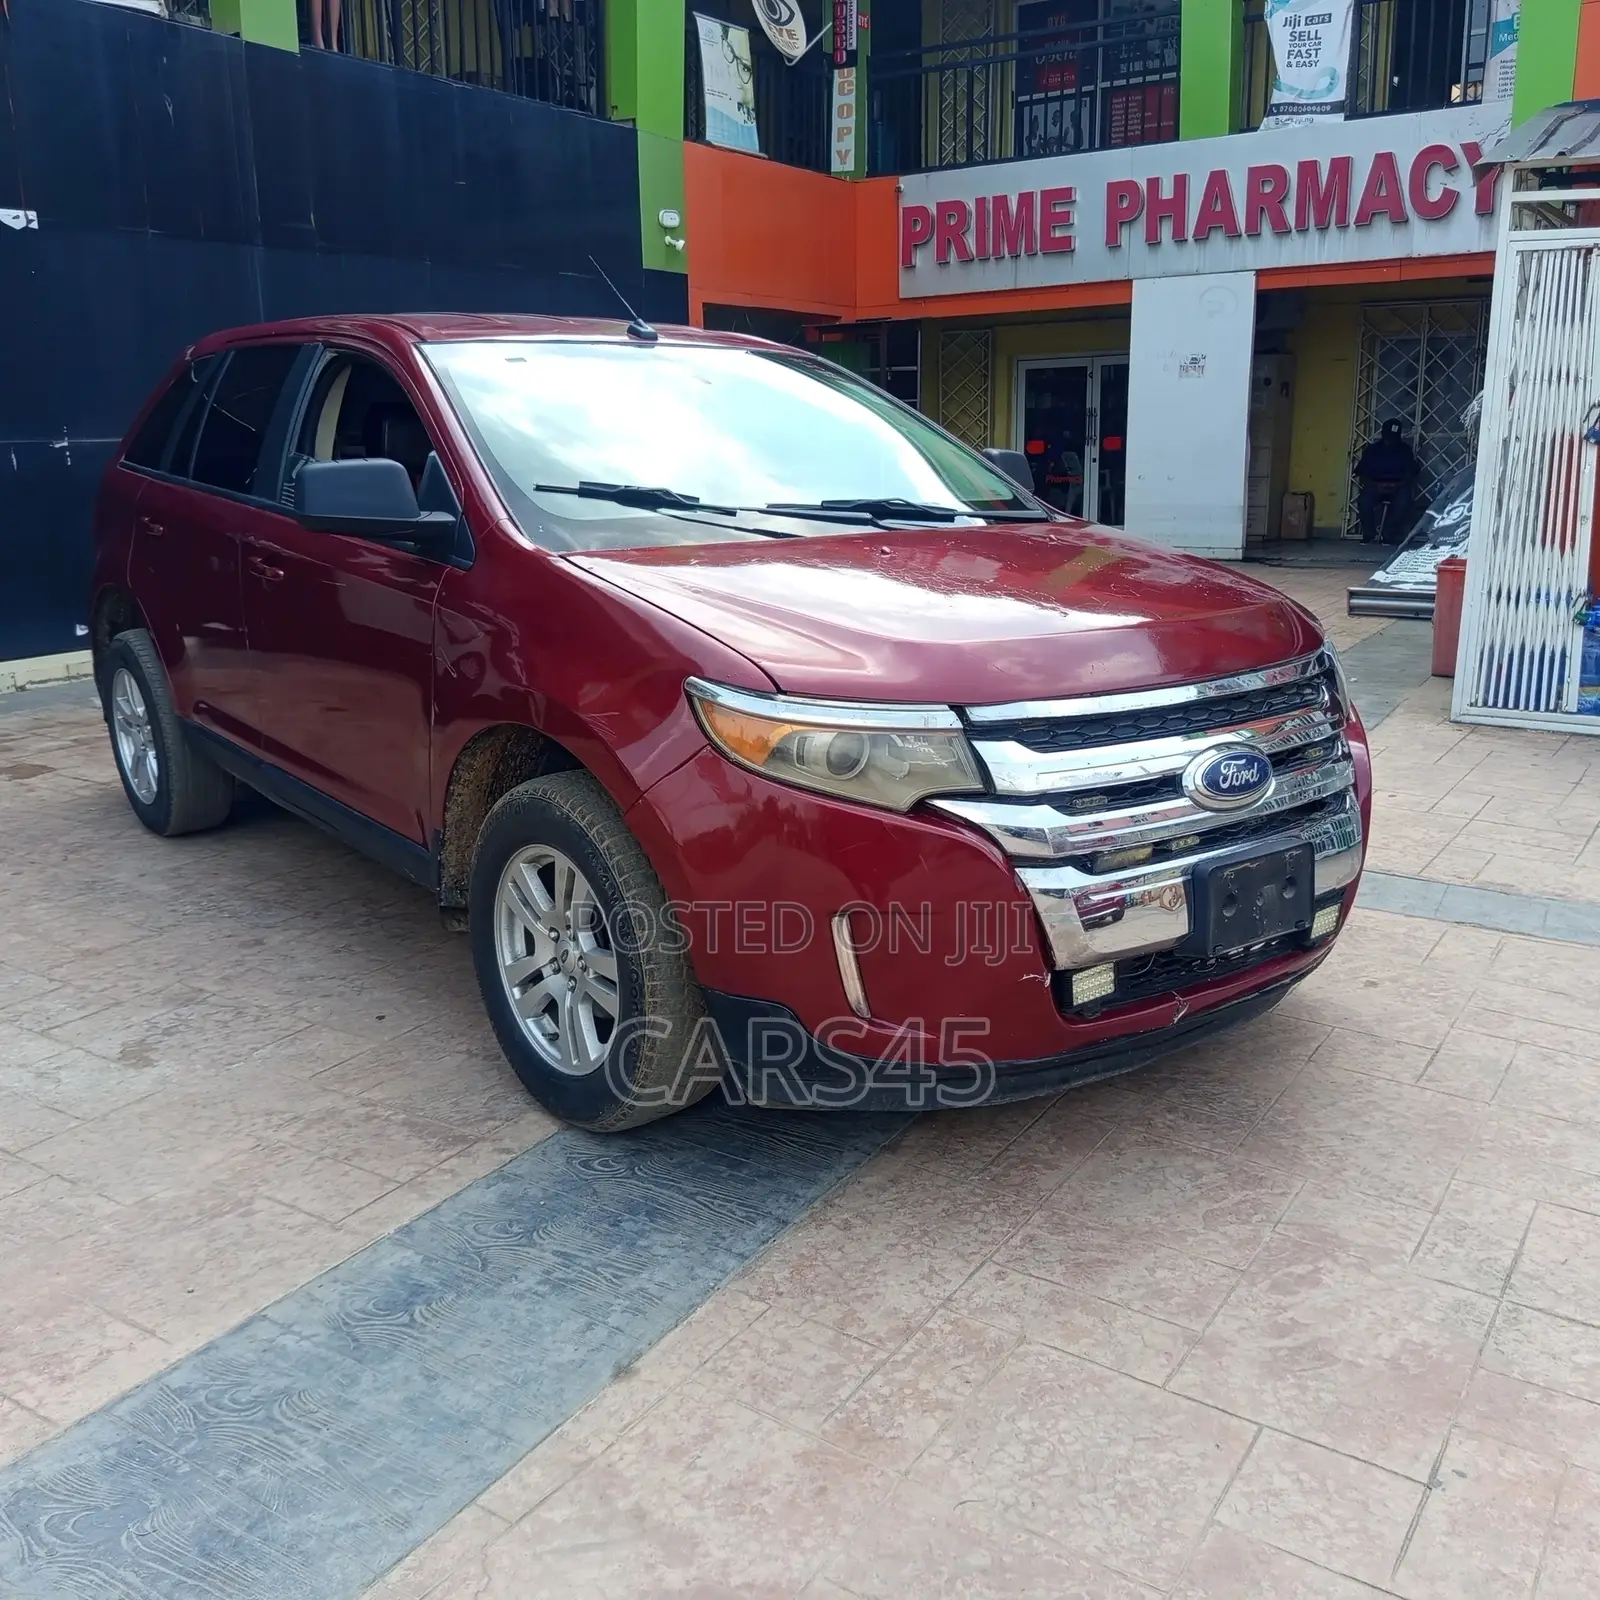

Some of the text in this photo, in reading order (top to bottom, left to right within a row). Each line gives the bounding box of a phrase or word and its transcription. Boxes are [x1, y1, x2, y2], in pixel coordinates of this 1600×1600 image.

[1282, 14, 1331, 29] Jiji cars
[1288, 29, 1322, 42] SELL
[1287, 48, 1321, 60] FAST
[1295, 60, 1320, 68] EASY
[901, 141, 1501, 268] PRIME PHARMACY
[1219, 758, 1260, 789] Ford
